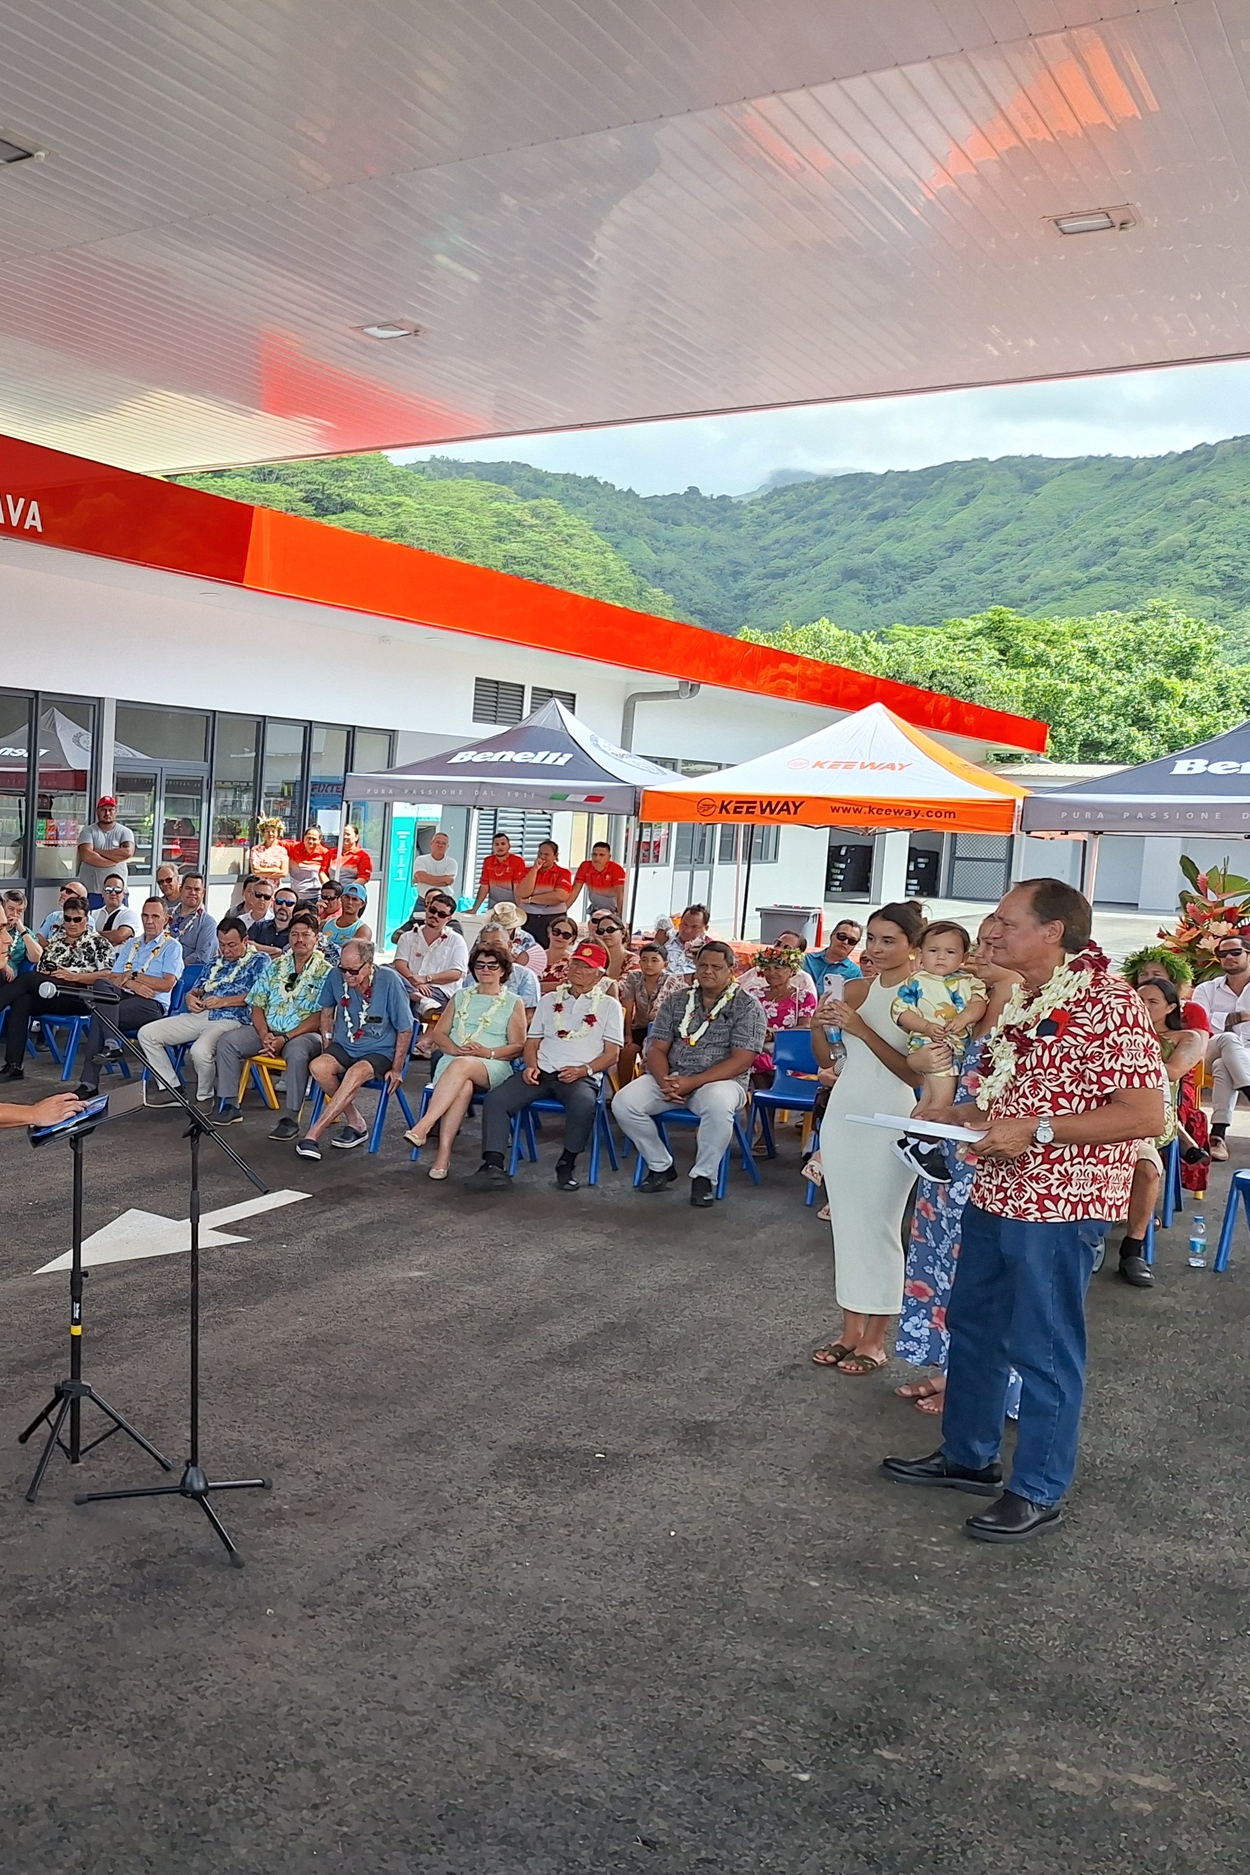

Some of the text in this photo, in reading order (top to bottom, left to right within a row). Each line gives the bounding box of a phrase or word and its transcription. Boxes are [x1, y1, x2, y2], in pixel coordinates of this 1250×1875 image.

[446, 750, 574, 767] Benelli
[811, 760, 914, 771] KEEWAY
[404, 788, 463, 796] PASSIONE
[474, 789, 495, 797] DAL
[718, 800, 957, 820] KEEWAY www.keeway.com
[1061, 811, 1104, 819] PURA
[1123, 811, 1221, 820] PASSIONE
